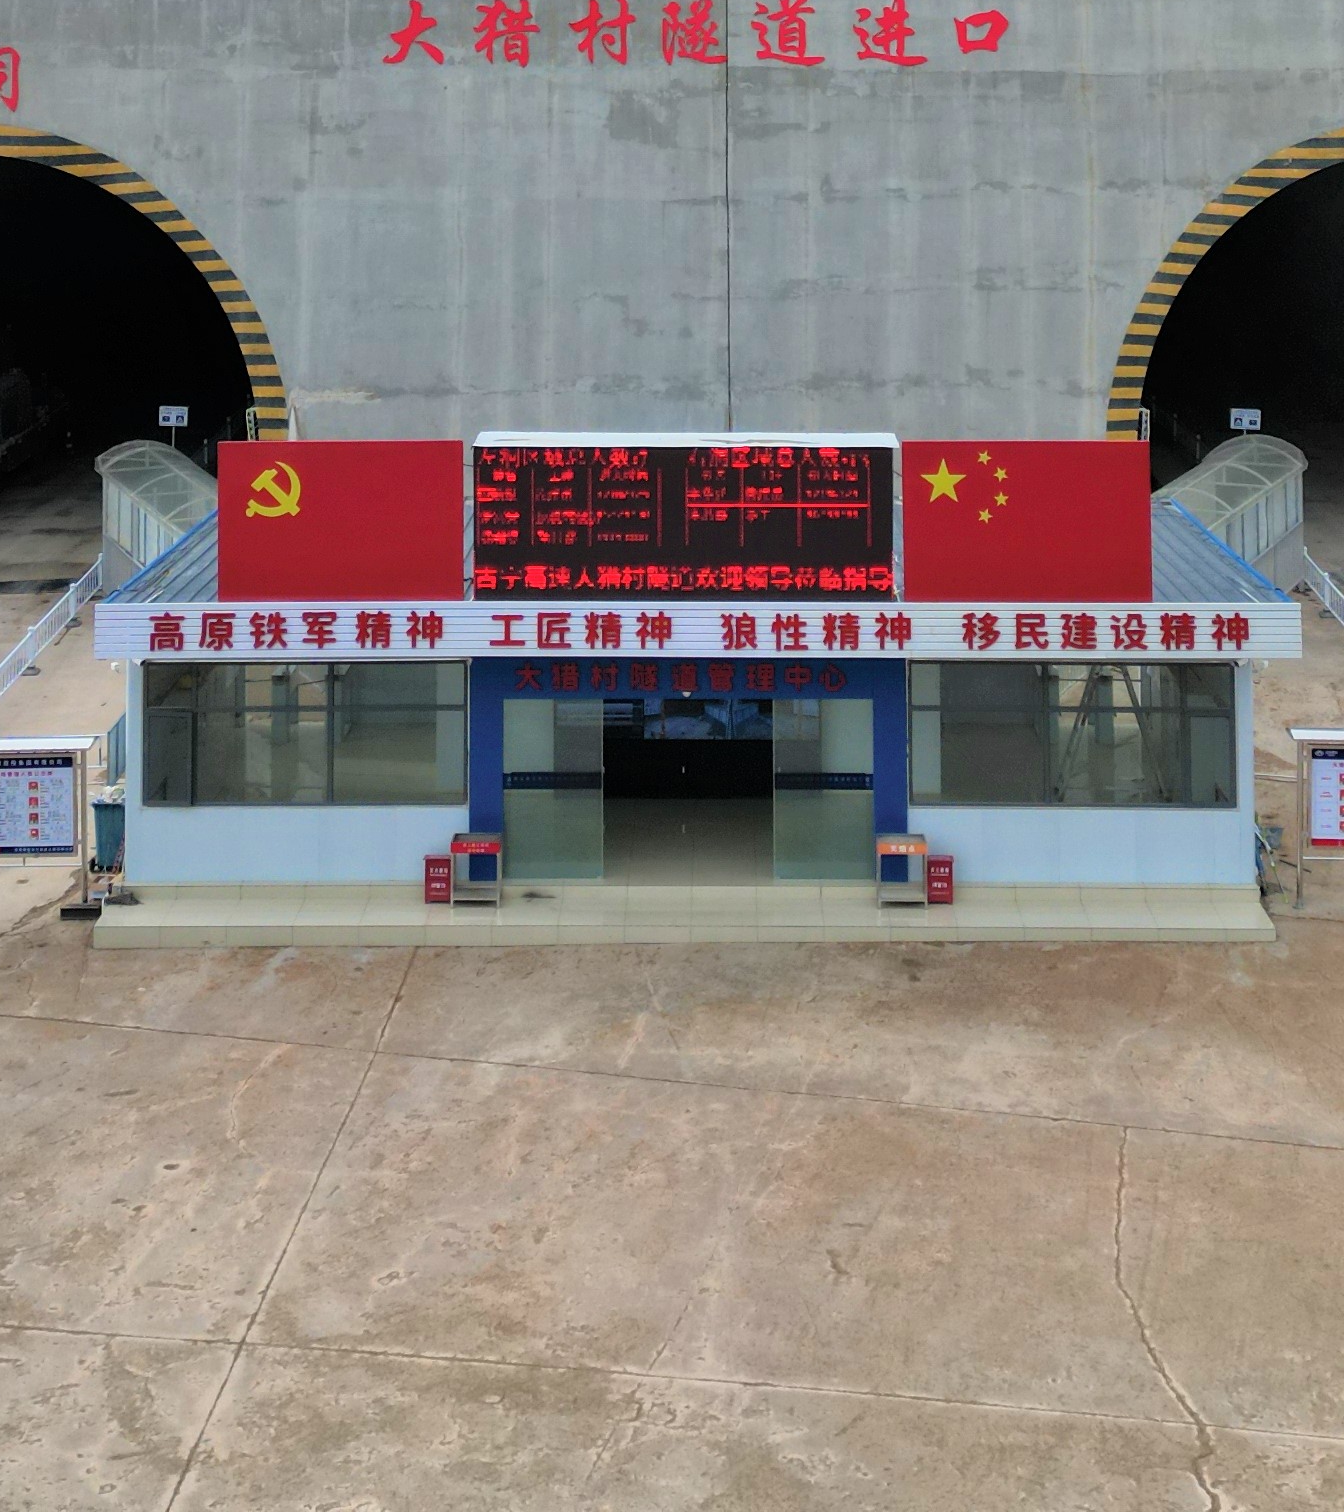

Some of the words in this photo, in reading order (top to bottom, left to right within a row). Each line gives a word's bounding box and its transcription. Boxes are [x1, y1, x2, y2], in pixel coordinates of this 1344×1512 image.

[149, 611, 445, 651] 高原铁军精神
[489, 611, 674, 651] 工匠精神
[721, 611, 913, 651] 狼性精神
[962, 611, 1250, 651] 移民建设精神
[515, 662, 848, 693] 大猎村隧道管理中心
